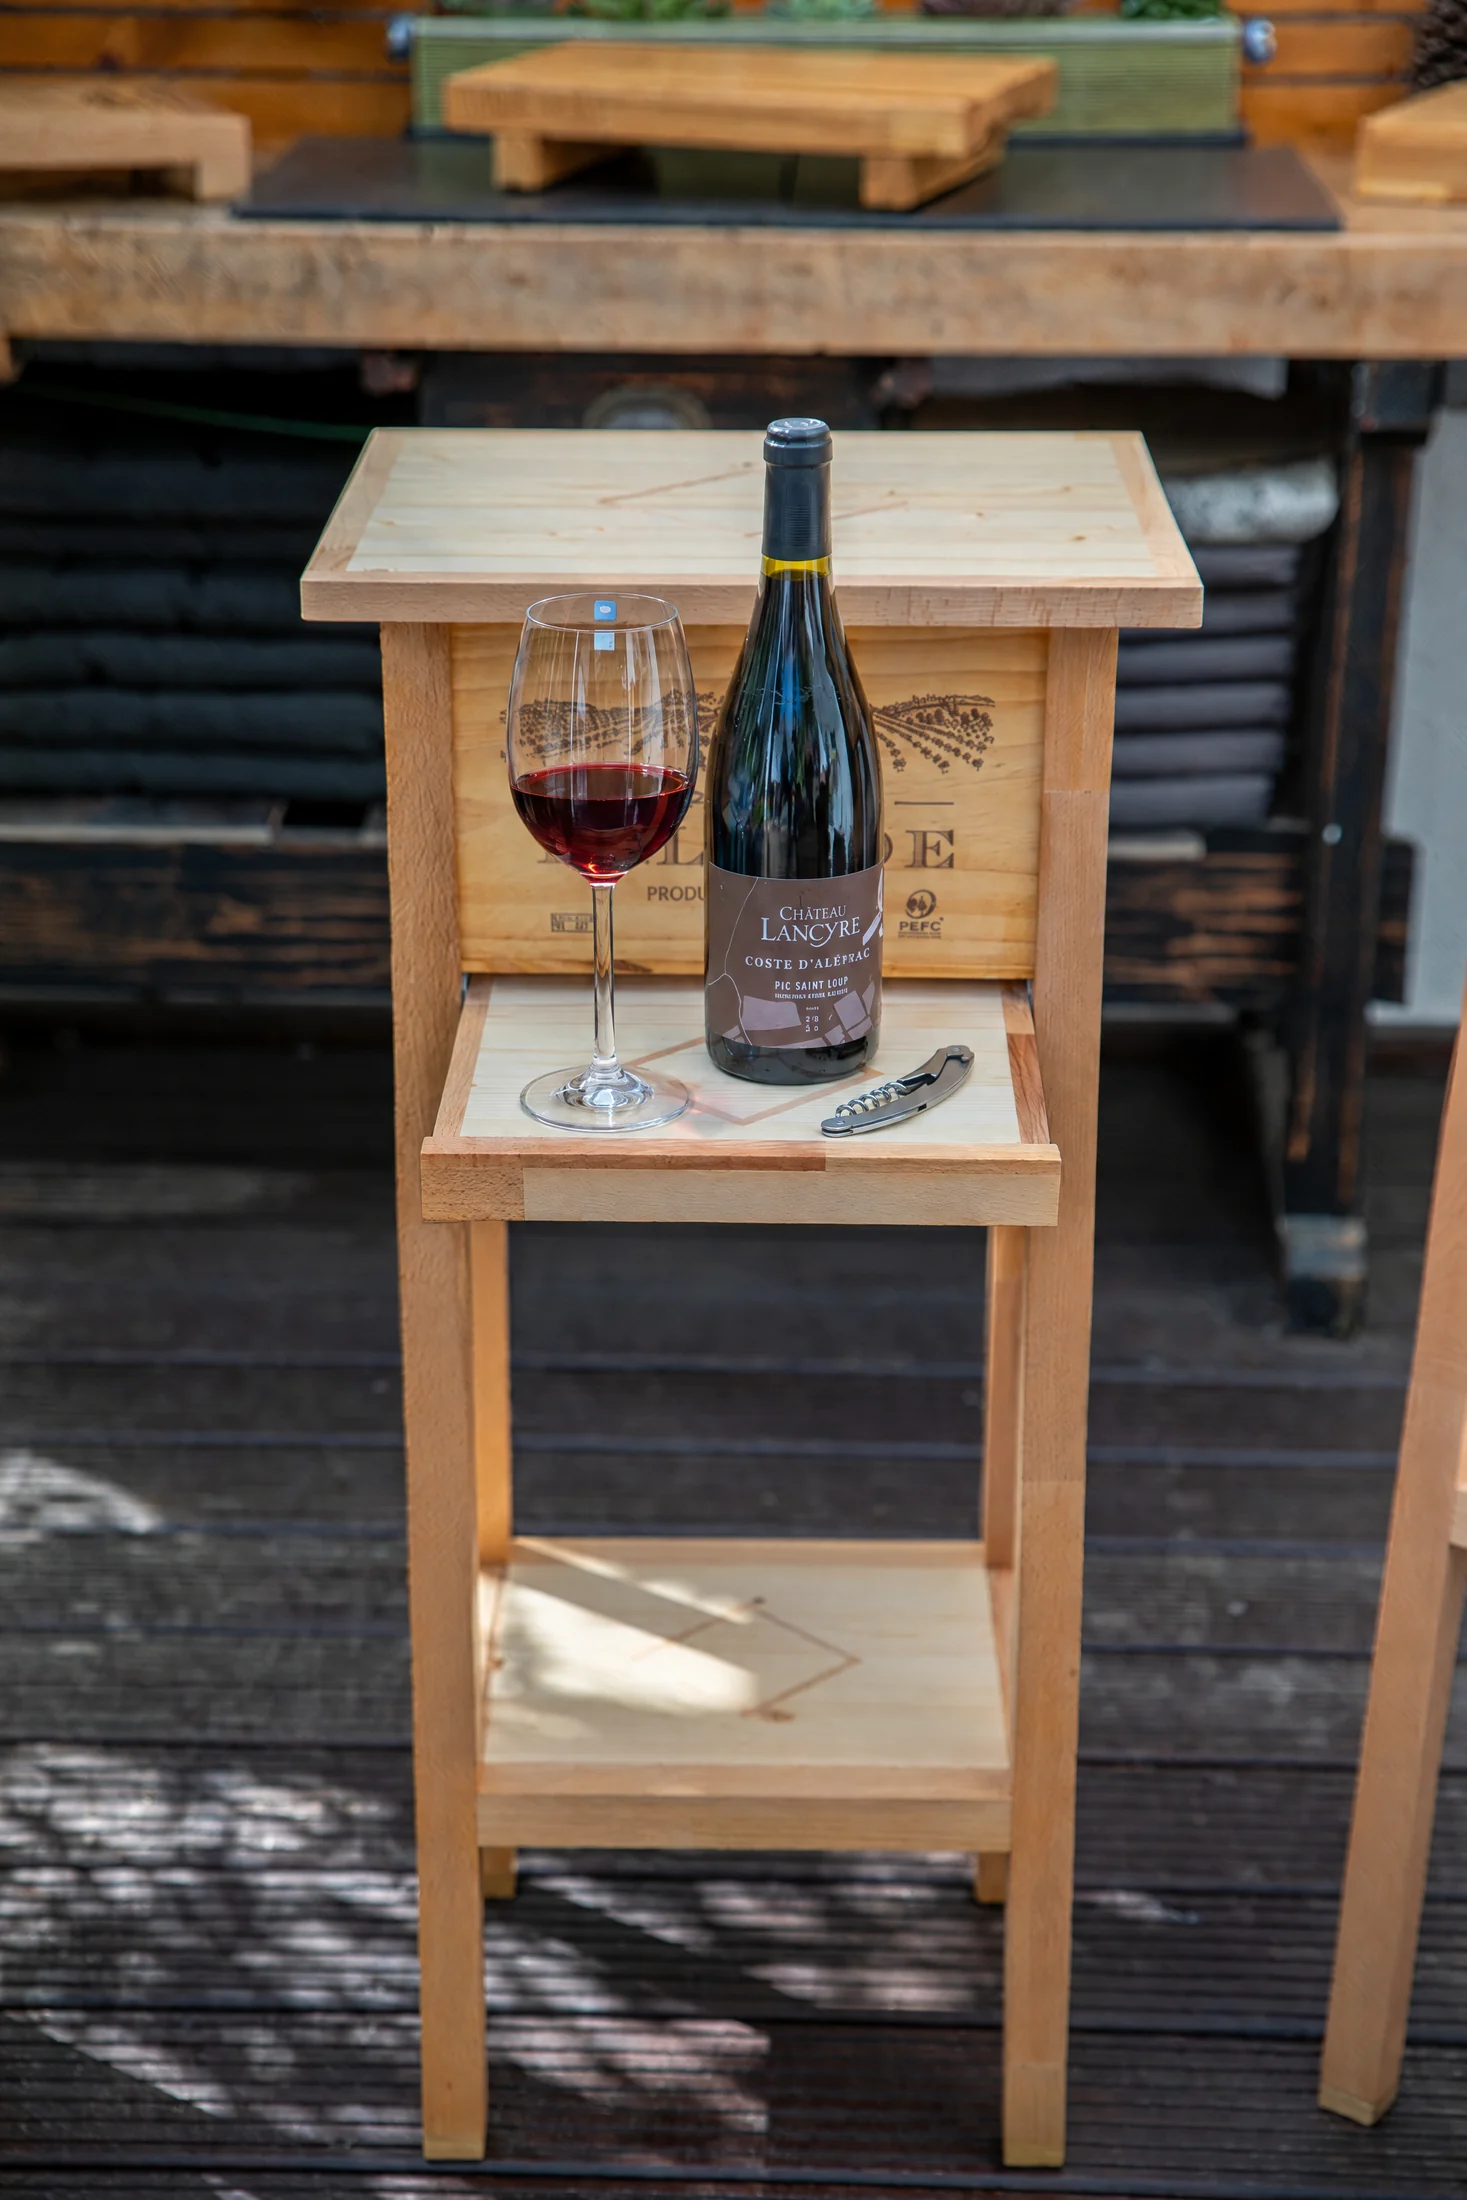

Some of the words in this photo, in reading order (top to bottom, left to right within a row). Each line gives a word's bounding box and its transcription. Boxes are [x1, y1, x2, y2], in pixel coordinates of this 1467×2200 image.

[780, 906, 846, 921] CHÂTEAU
[761, 917, 860, 948] LANCYRE
[898, 921, 942, 932] PEFC
[744, 956, 793, 970] COSTE
[774, 981, 791, 991] PIC
[795, 980, 824, 991] SAINT
[827, 977, 848, 990] LOUP
